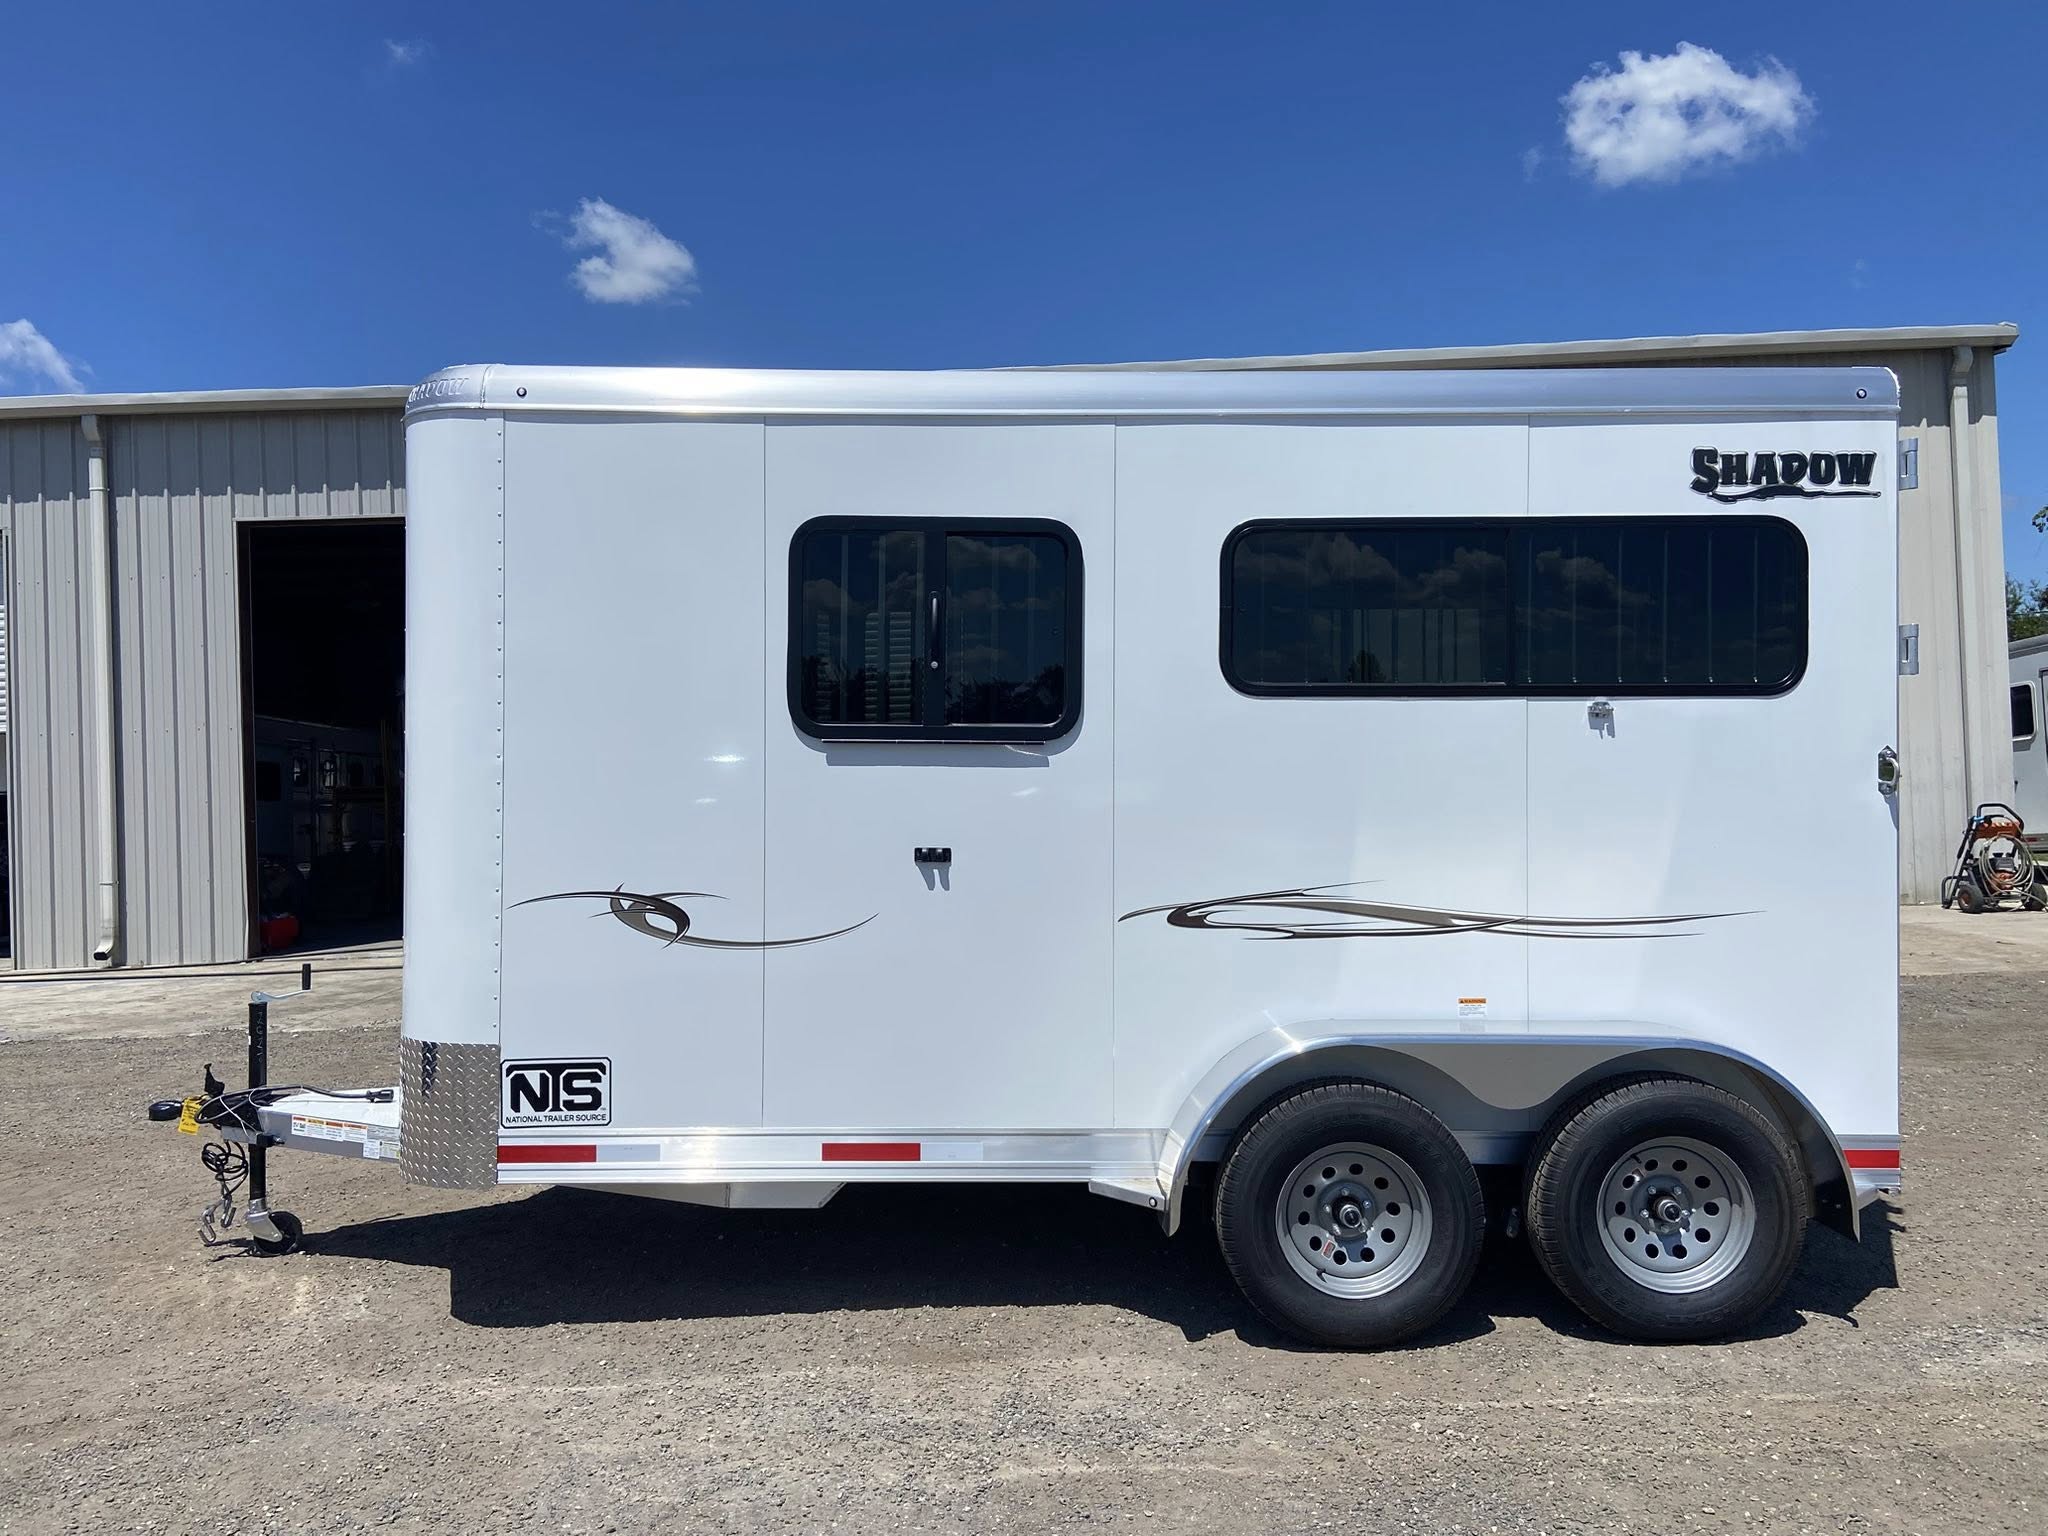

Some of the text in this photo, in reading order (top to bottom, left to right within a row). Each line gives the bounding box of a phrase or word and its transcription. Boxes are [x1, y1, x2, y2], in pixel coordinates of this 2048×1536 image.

[1690, 446, 1877, 495] SHADOW
[505, 1062, 607, 1113] NTS
[505, 1113, 607, 1123] NATIONAL TRAILER SOURCE
